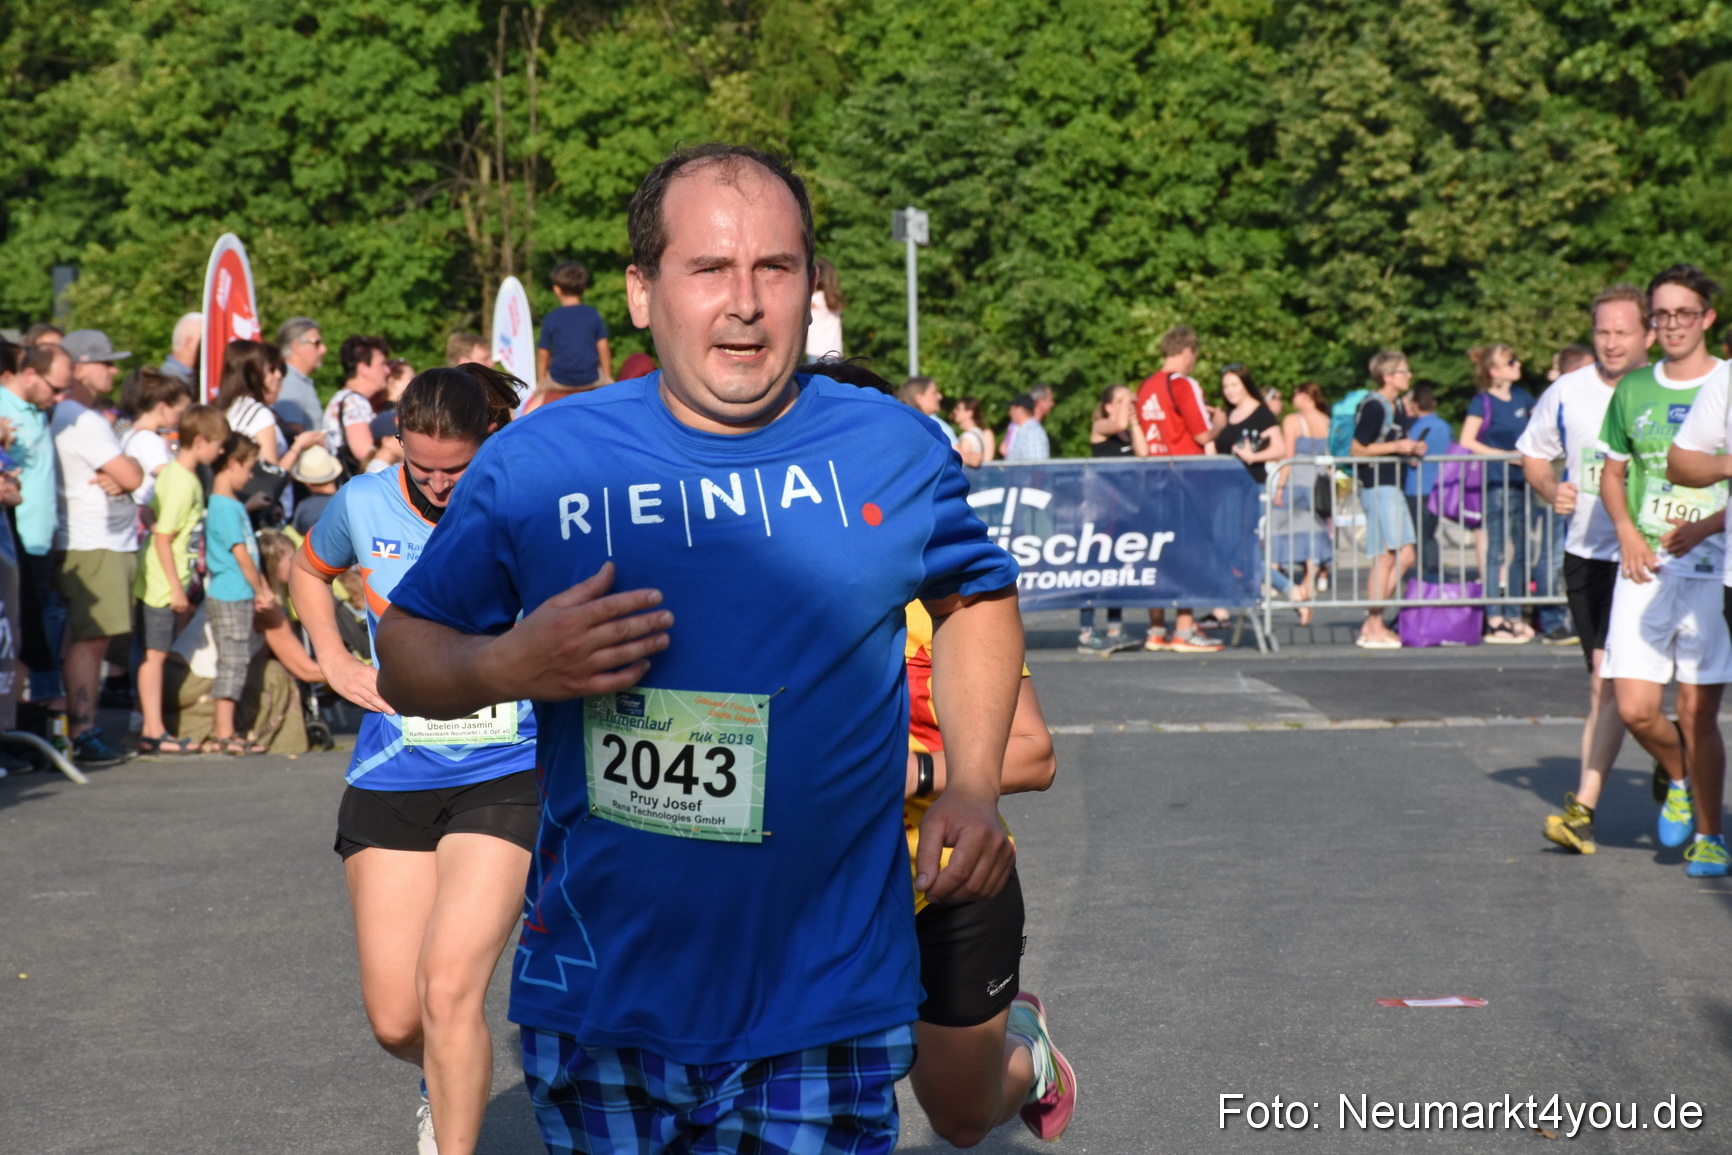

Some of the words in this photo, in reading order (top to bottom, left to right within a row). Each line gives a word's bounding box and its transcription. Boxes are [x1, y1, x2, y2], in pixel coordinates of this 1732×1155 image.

[407, 542, 424, 551] Rai
[986, 523, 1175, 566] ischer
[1017, 566, 1157, 591] TOMOBILE
[427, 721, 459, 730] Übelein
[461, 721, 493, 730] Jasmin
[606, 708, 674, 732] firmenlauf
[718, 733, 754, 745] 2019
[602, 734, 737, 798] 2043
[612, 800, 631, 813] Rena
[633, 805, 691, 823] Technologies
[695, 815, 726, 825] GmbH
[630, 790, 659, 809] Pruy
[663, 796, 703, 812] Josef
